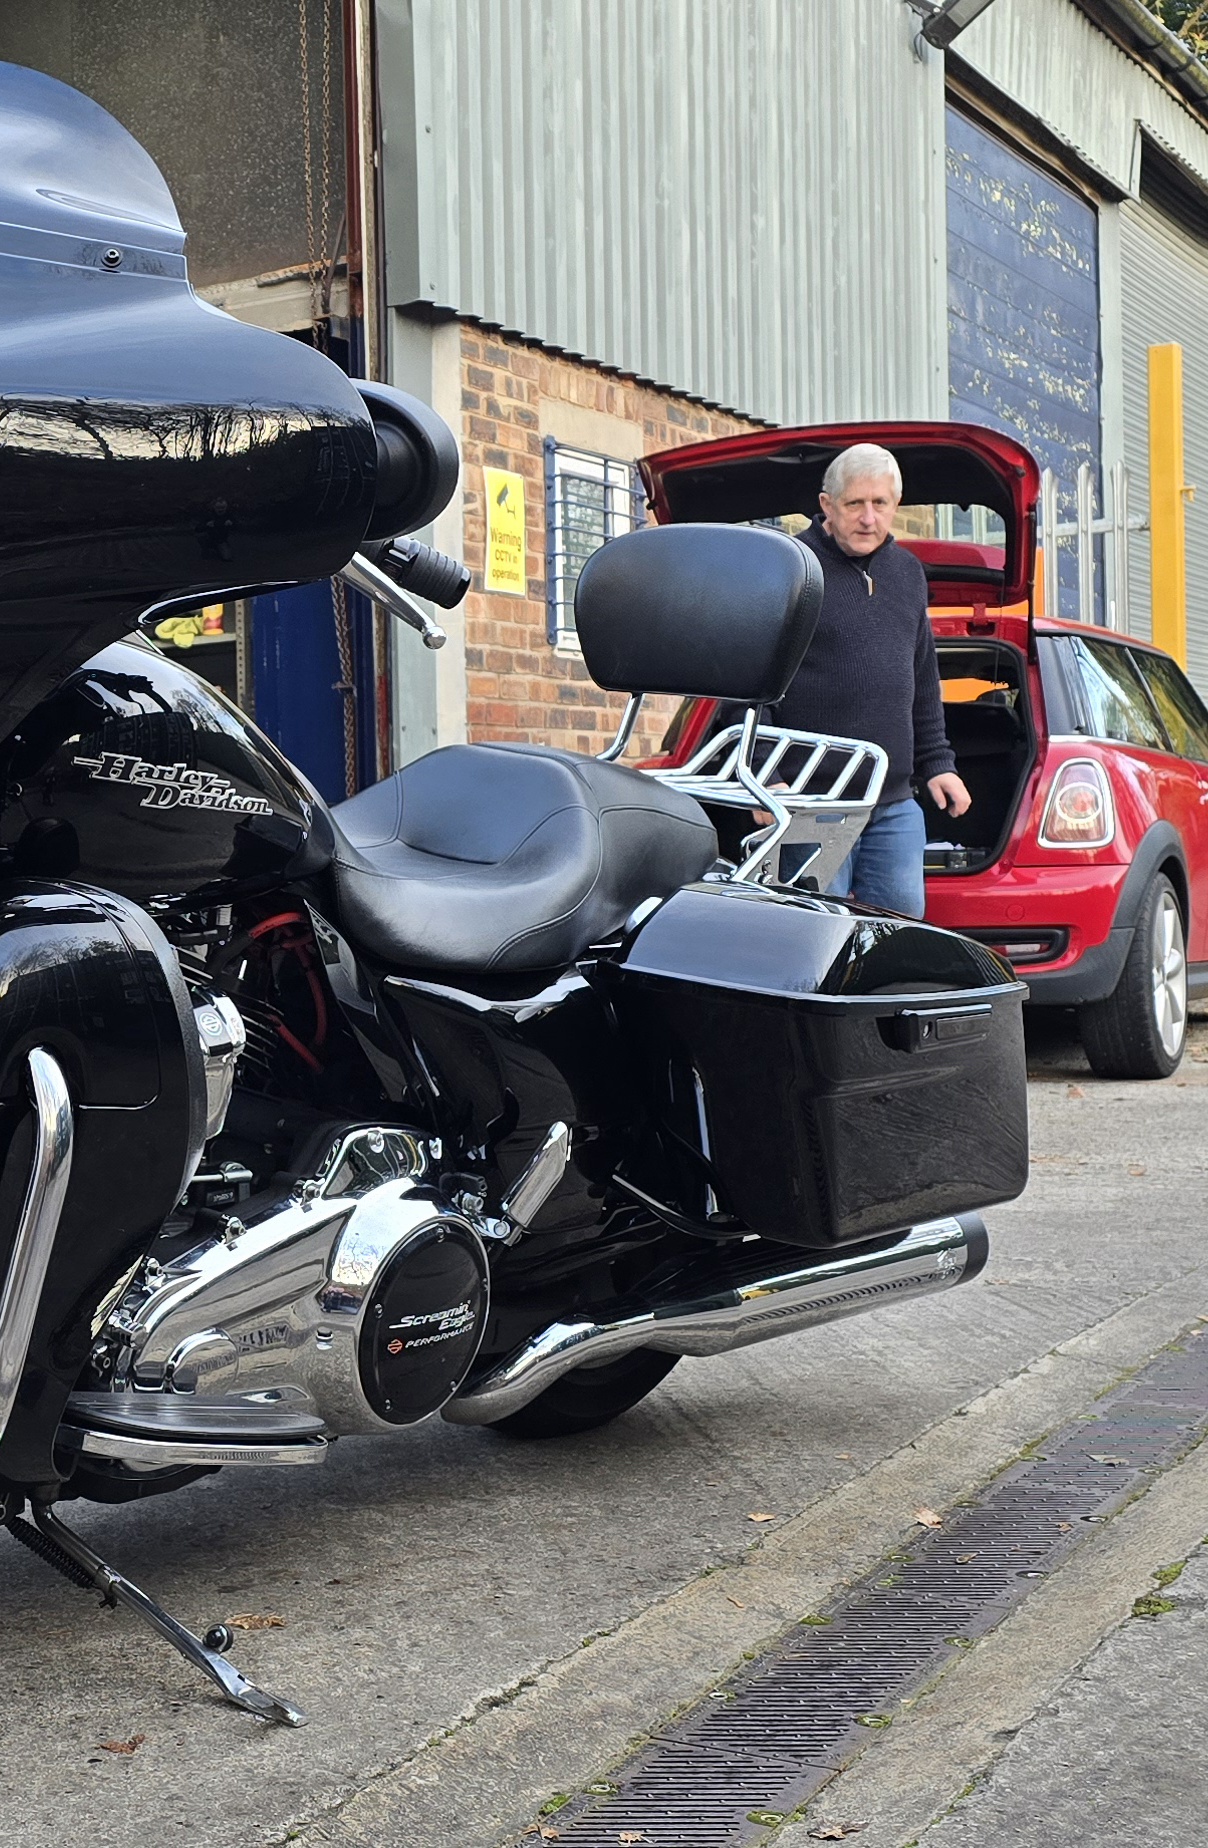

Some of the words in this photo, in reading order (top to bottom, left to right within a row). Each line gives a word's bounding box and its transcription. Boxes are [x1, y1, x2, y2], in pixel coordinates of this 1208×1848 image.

[490, 527, 522, 552] Warning
[495, 549, 511, 563] CCTV
[492, 568, 520, 582] operation
[140, 783, 273, 816] Davidson
[438, 1311, 476, 1331] Eagle
[405, 1321, 475, 1348] PERFORMANCE
